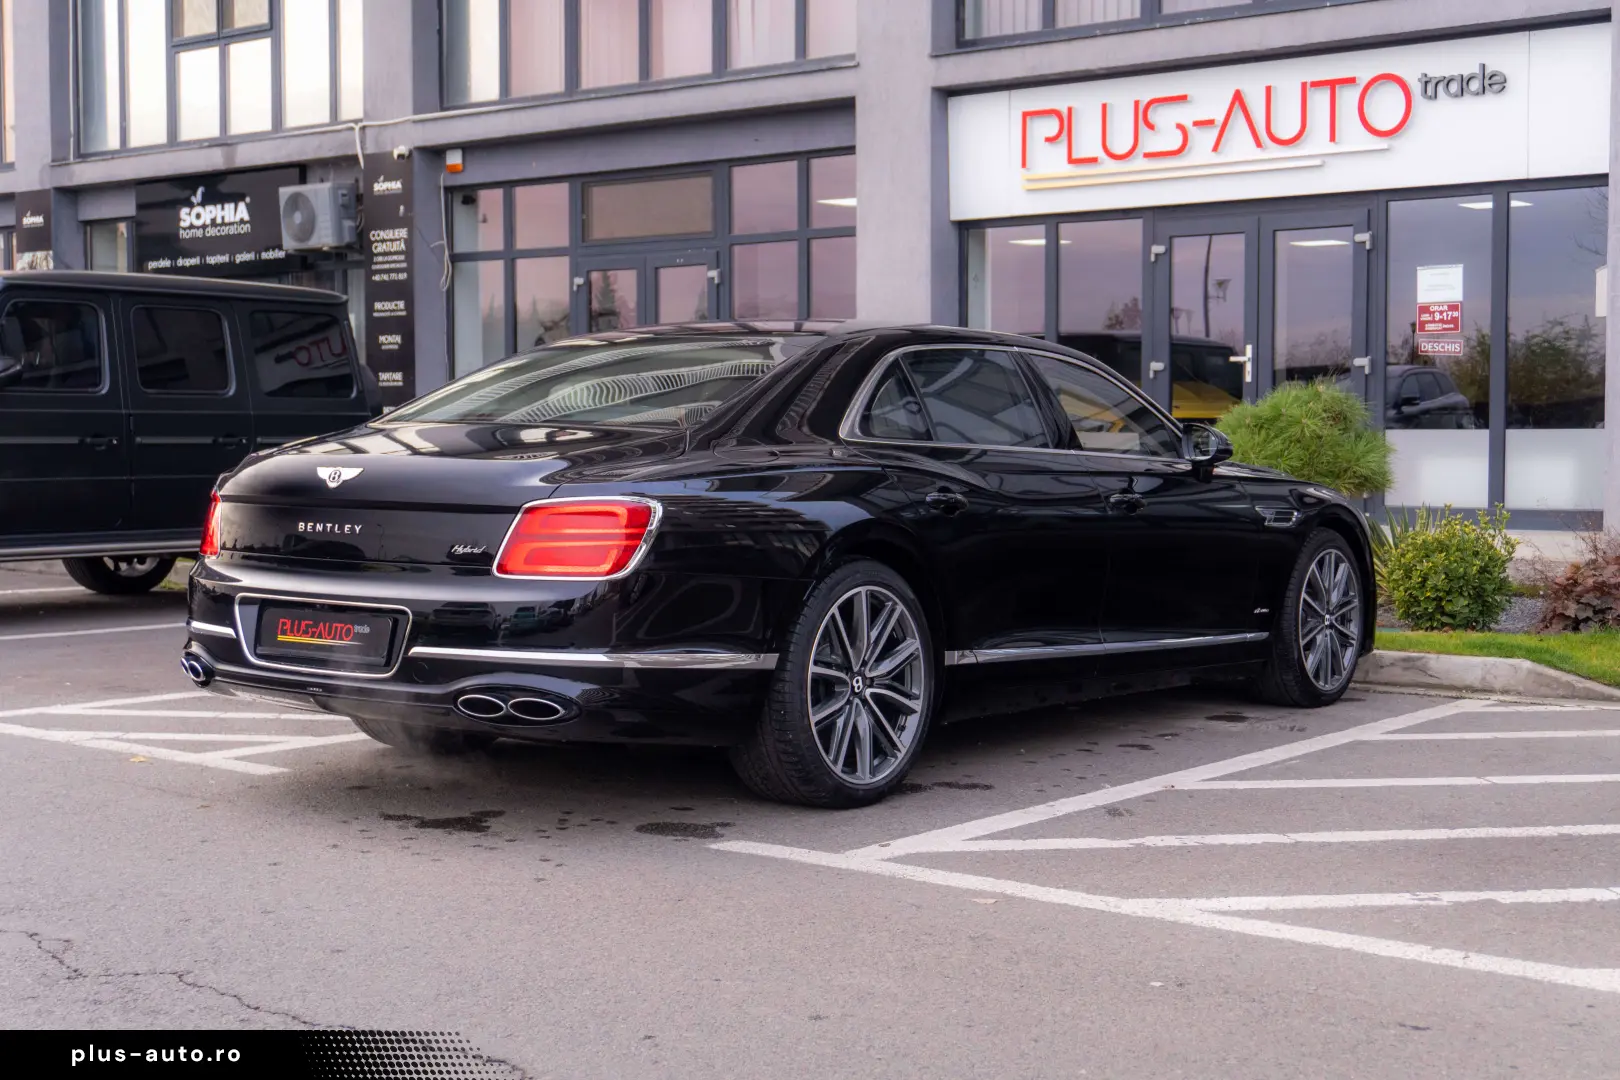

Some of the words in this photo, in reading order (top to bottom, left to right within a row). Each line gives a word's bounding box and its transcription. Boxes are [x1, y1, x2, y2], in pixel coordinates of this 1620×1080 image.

[1021, 72, 1413, 169] PLUS-AUTO
[1417, 63, 1507, 100] trade
[373, 180, 402, 191] SOPHIA
[179, 201, 250, 227] SOPHIA
[179, 227, 204, 239] home
[205, 222, 251, 238] decoration
[148, 257, 171, 271] perdele
[176, 254, 200, 268] draperii
[1421, 342, 1460, 352] DESCHIS
[298, 522, 363, 534] BENTLEY
[451, 544, 486, 556] Hybrid
[277, 618, 354, 641] PLUS-AUTO
